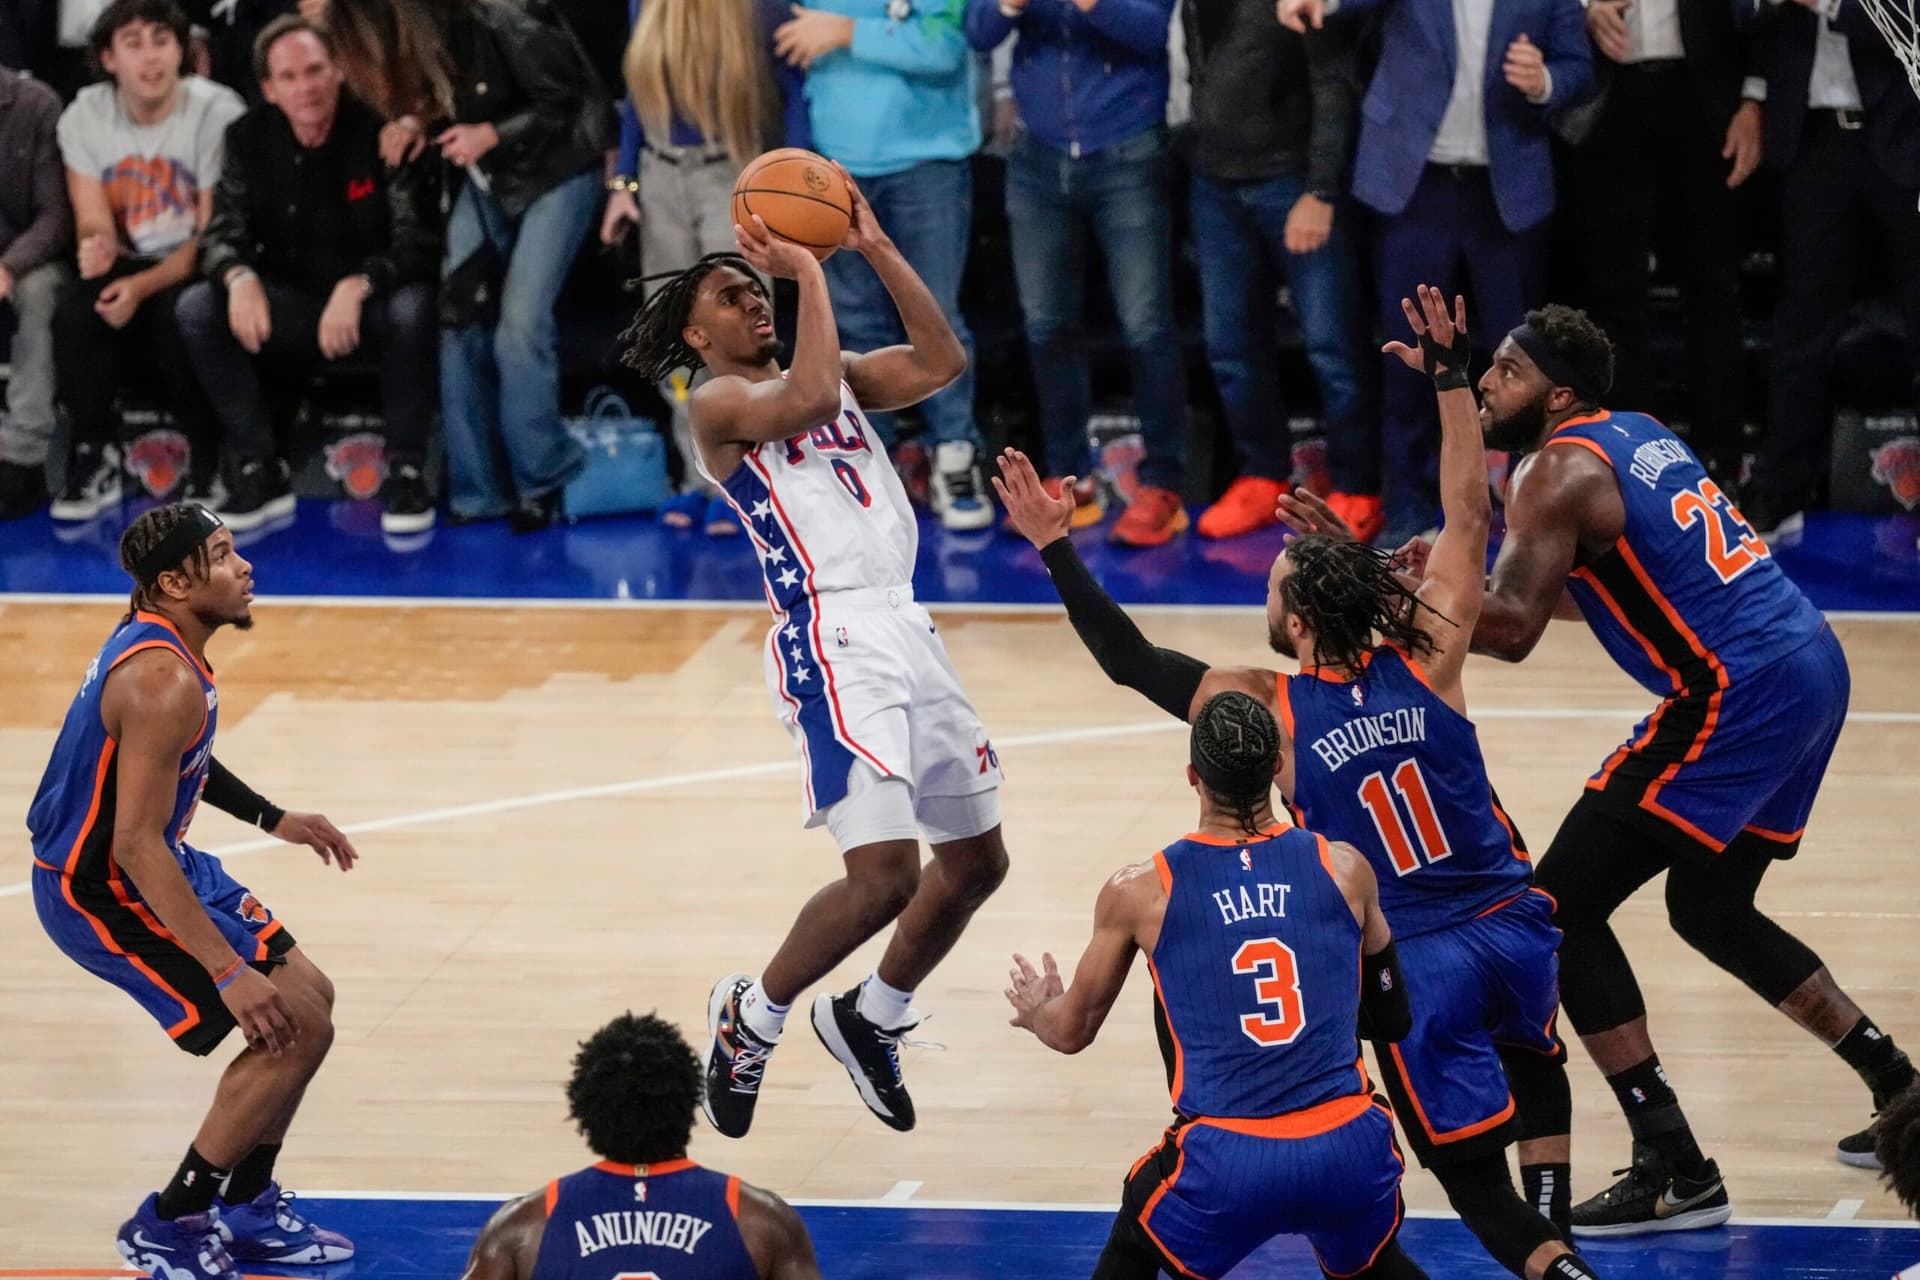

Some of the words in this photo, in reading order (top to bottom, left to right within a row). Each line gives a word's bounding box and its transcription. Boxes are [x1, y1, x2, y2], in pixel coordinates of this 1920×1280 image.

[831, 458, 871, 508] 0
[1671, 477, 1771, 584] 23
[1311, 707, 1425, 772] BRUNSON
[1357, 757, 1452, 877] 11
[1212, 883, 1291, 925] HART
[1231, 937, 1306, 1047] 3
[575, 1211, 713, 1257] ANUNOBY
